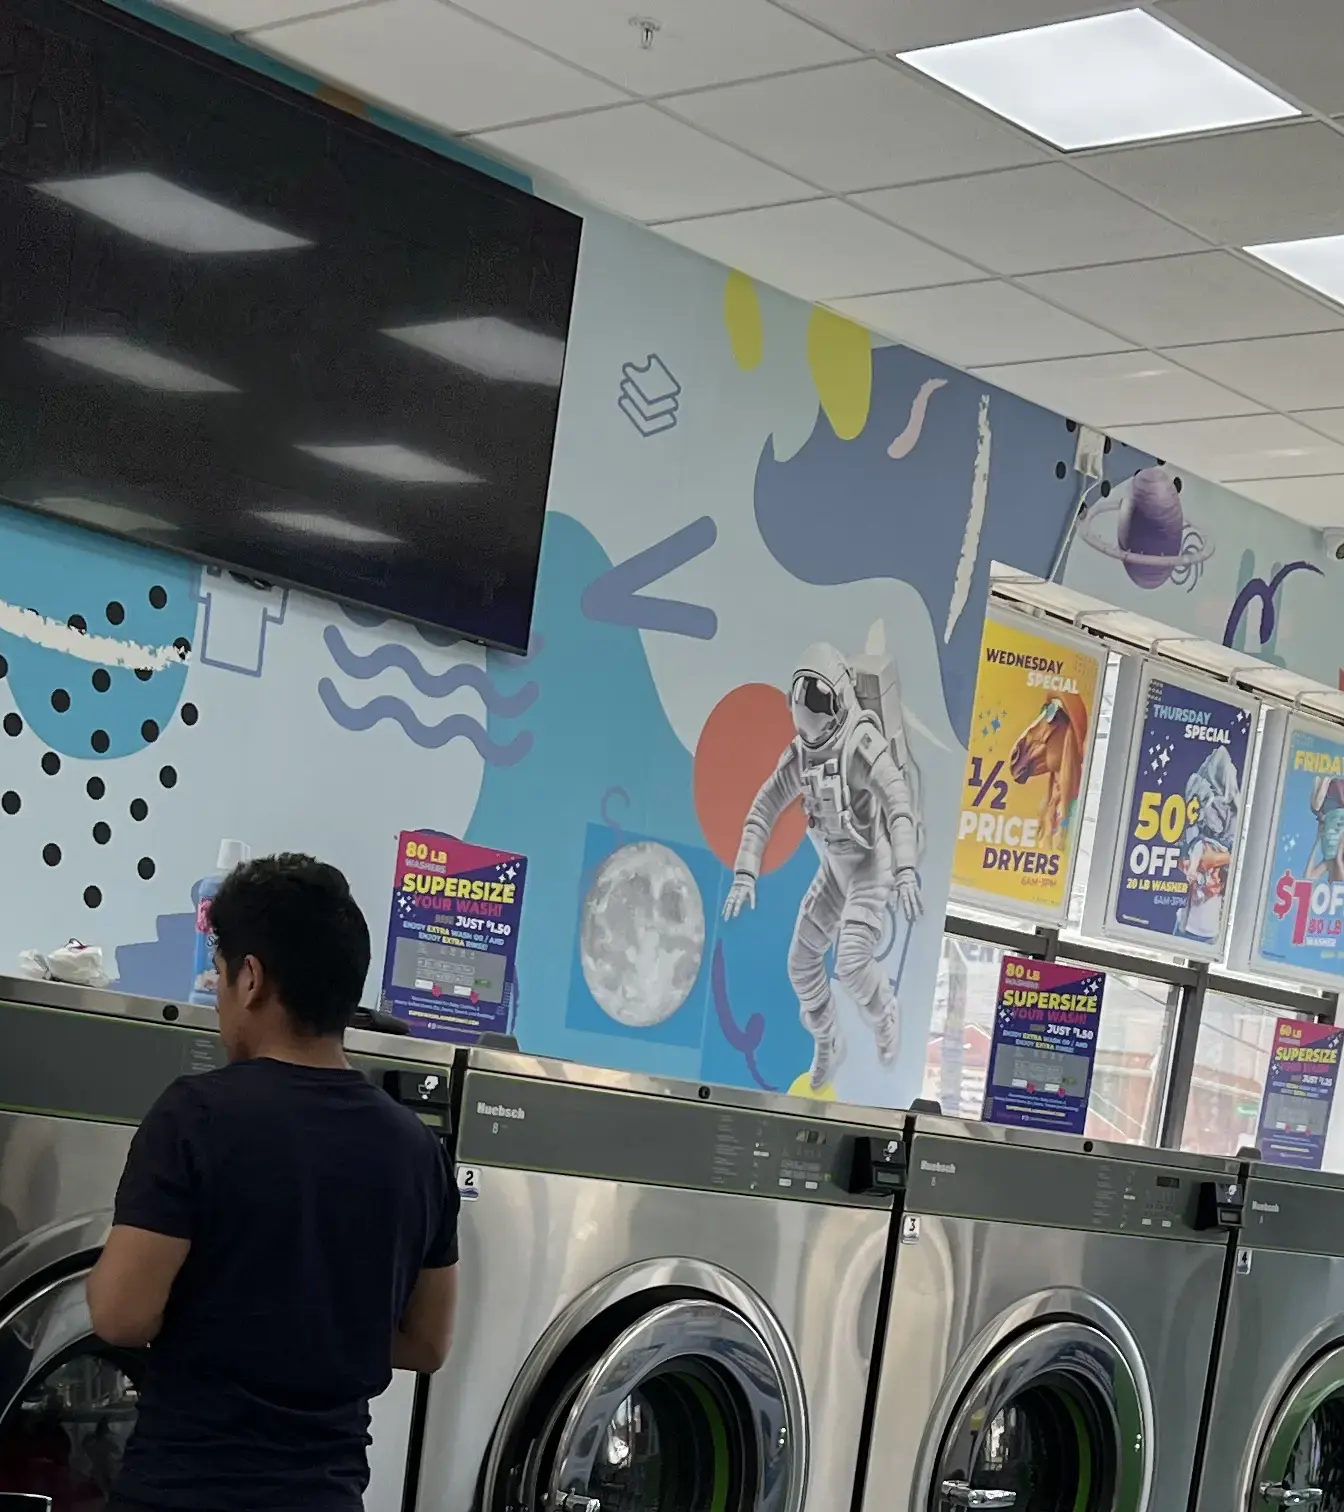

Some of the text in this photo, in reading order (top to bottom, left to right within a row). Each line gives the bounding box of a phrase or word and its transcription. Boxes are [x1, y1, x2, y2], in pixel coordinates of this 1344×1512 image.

[986, 647, 1064, 675] WEDNESDAY
[1026, 670, 1080, 695] SPECIAL
[1153, 704, 1212, 725] THURSDAY
[1184, 724, 1231, 745] SPECIAL
[1134, 791, 1200, 843] 50¢
[957, 810, 1040, 848] PRICE
[405, 841, 448, 864] 80 LB
[982, 847, 1061, 876] DRYERS
[1130, 843, 1181, 877] OFF
[402, 872, 516, 904] SUPERSIZE
[1139, 879, 1151, 890] LB
[1152, 880, 1188, 893] WASHER
[414, 894, 503, 917] YOUR WASH!
[1273, 869, 1314, 946] $1
[456, 915, 486, 931] JUST
[486, 919, 512, 936] $1.50
[1006, 963, 1040, 981] 80 LB
[1002, 989, 1098, 1013] SUPERSIZE
[1046, 1023, 1071, 1036] JUST
[1275, 1046, 1338, 1064] SUPERSIZE
[477, 1102, 526, 1119] Huebsch
[464, 1170, 474, 1186] 2
[909, 1218, 916, 1232] 3
